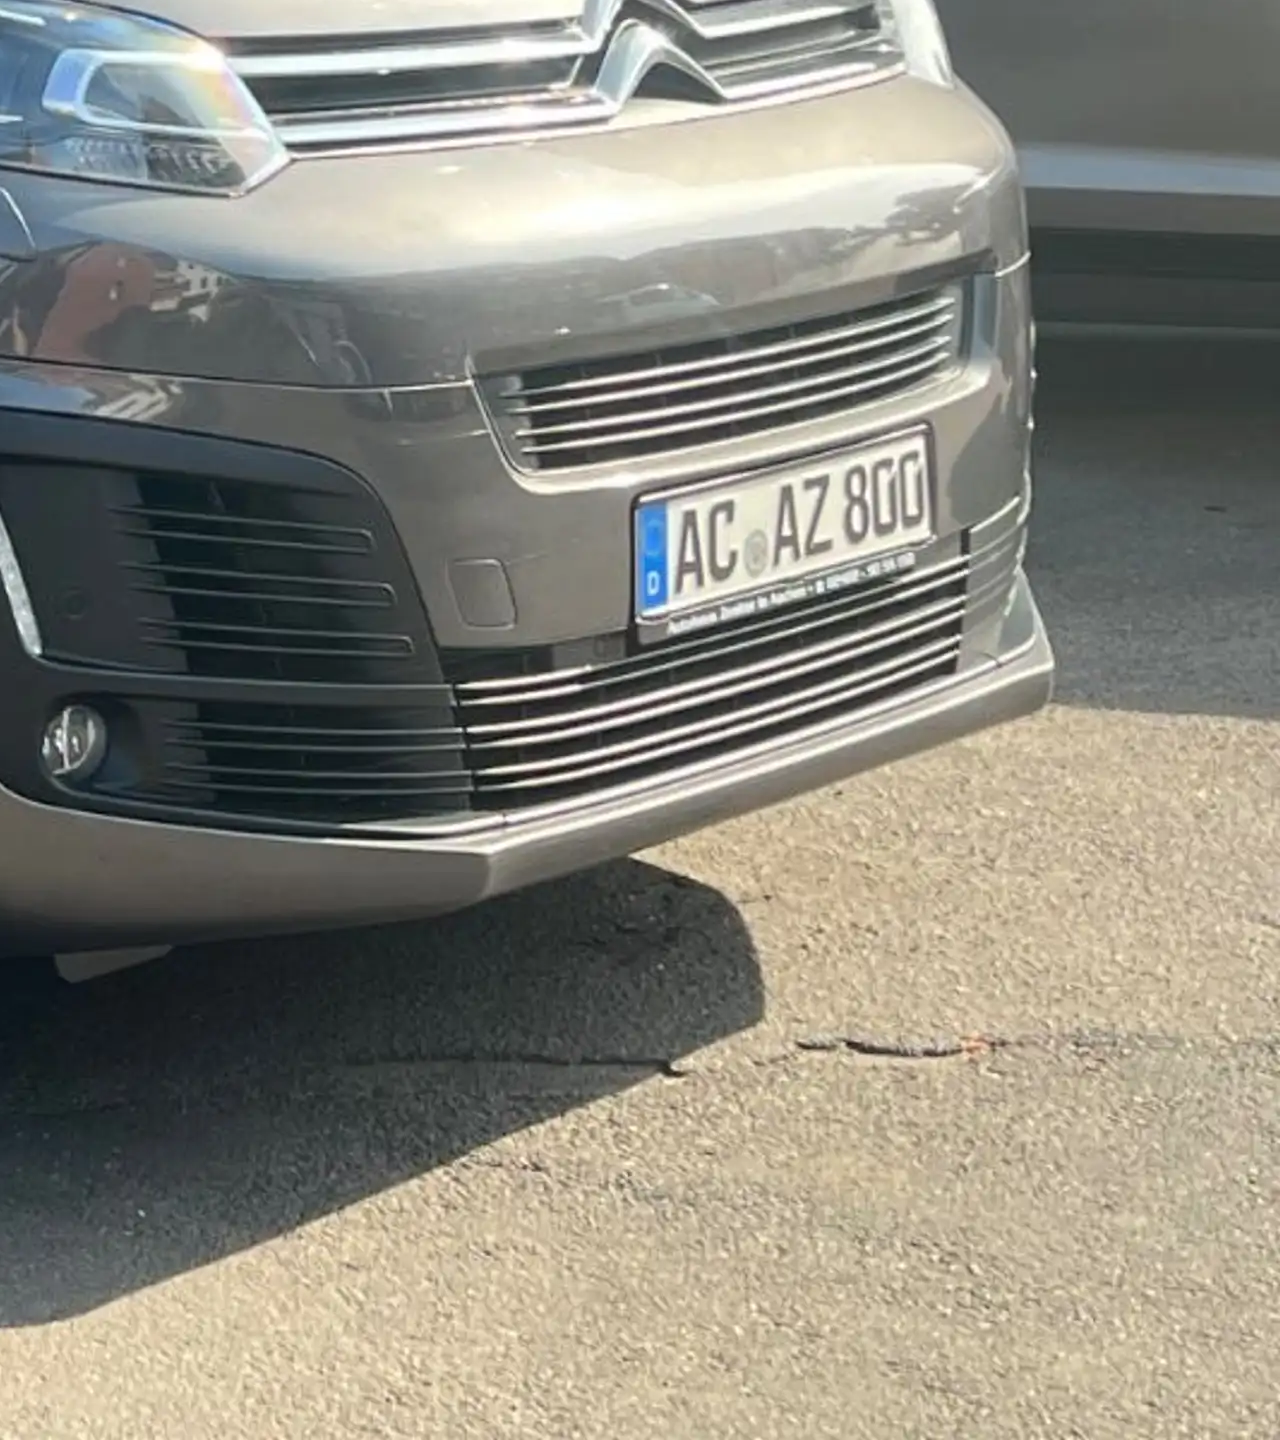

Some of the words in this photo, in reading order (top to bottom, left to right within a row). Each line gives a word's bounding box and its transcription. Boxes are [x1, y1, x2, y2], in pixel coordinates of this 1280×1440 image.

[674, 497, 738, 595] AC
[772, 473, 834, 567] AZ
[844, 449, 925, 546] 800
[646, 570, 660, 596] D
